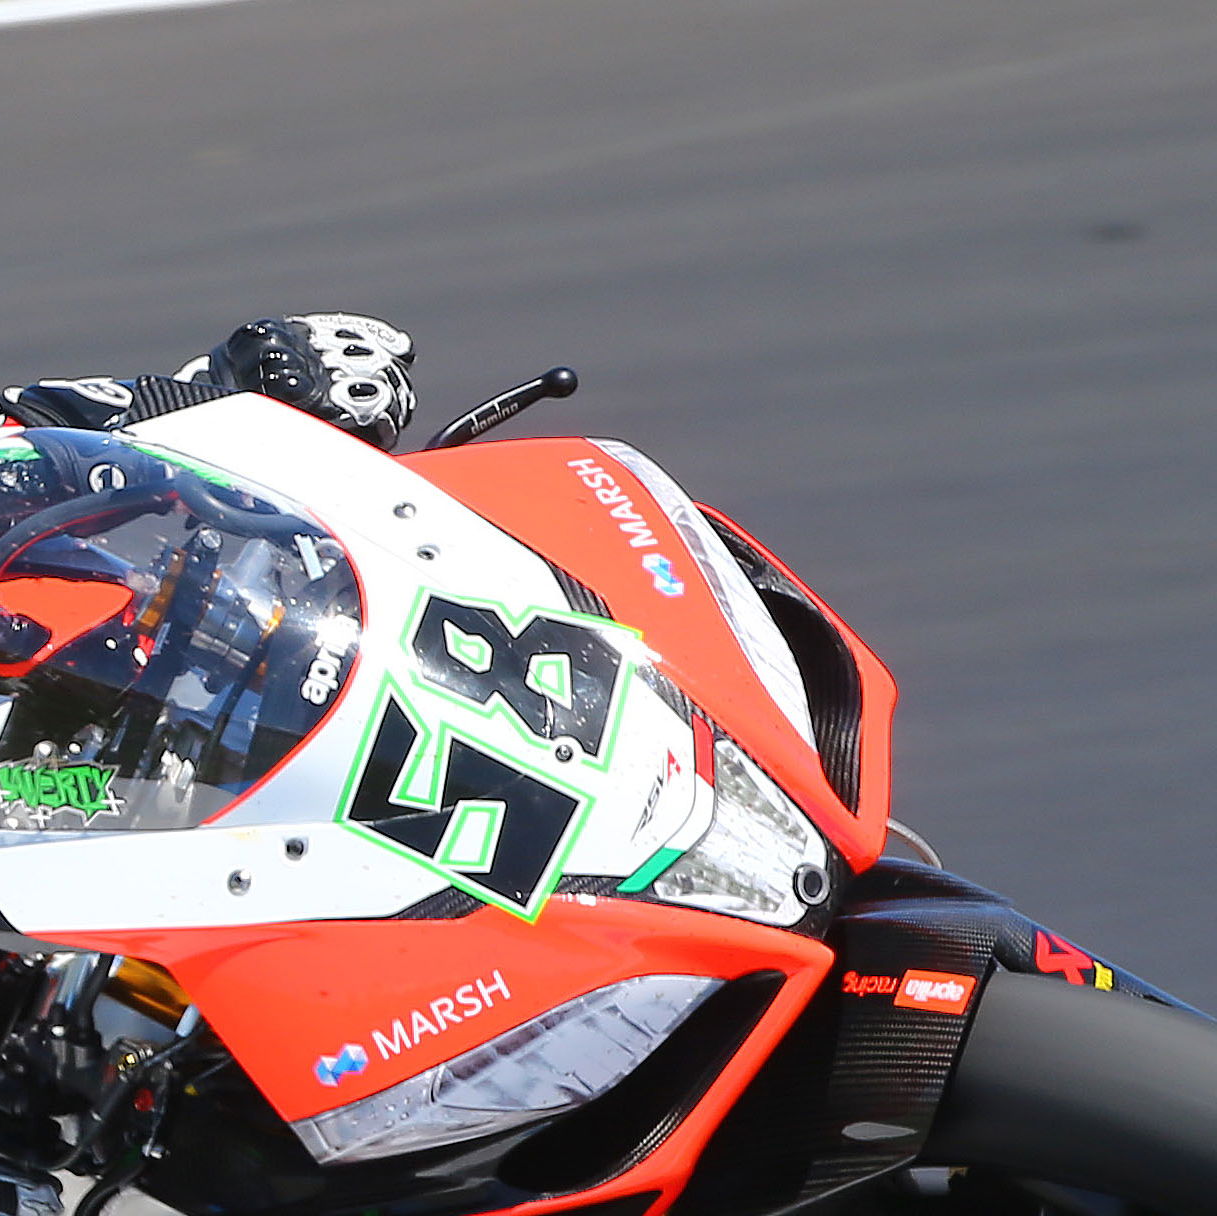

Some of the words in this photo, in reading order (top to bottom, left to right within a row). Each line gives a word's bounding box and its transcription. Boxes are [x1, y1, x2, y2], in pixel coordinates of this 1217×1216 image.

[568, 458, 659, 548] MARSH
[300, 614, 360, 706] apri
[344, 593, 624, 910] 58
[371, 969, 511, 1060] MARSH
[843, 970, 897, 996] racing
[905, 979, 964, 1002] aprilia
